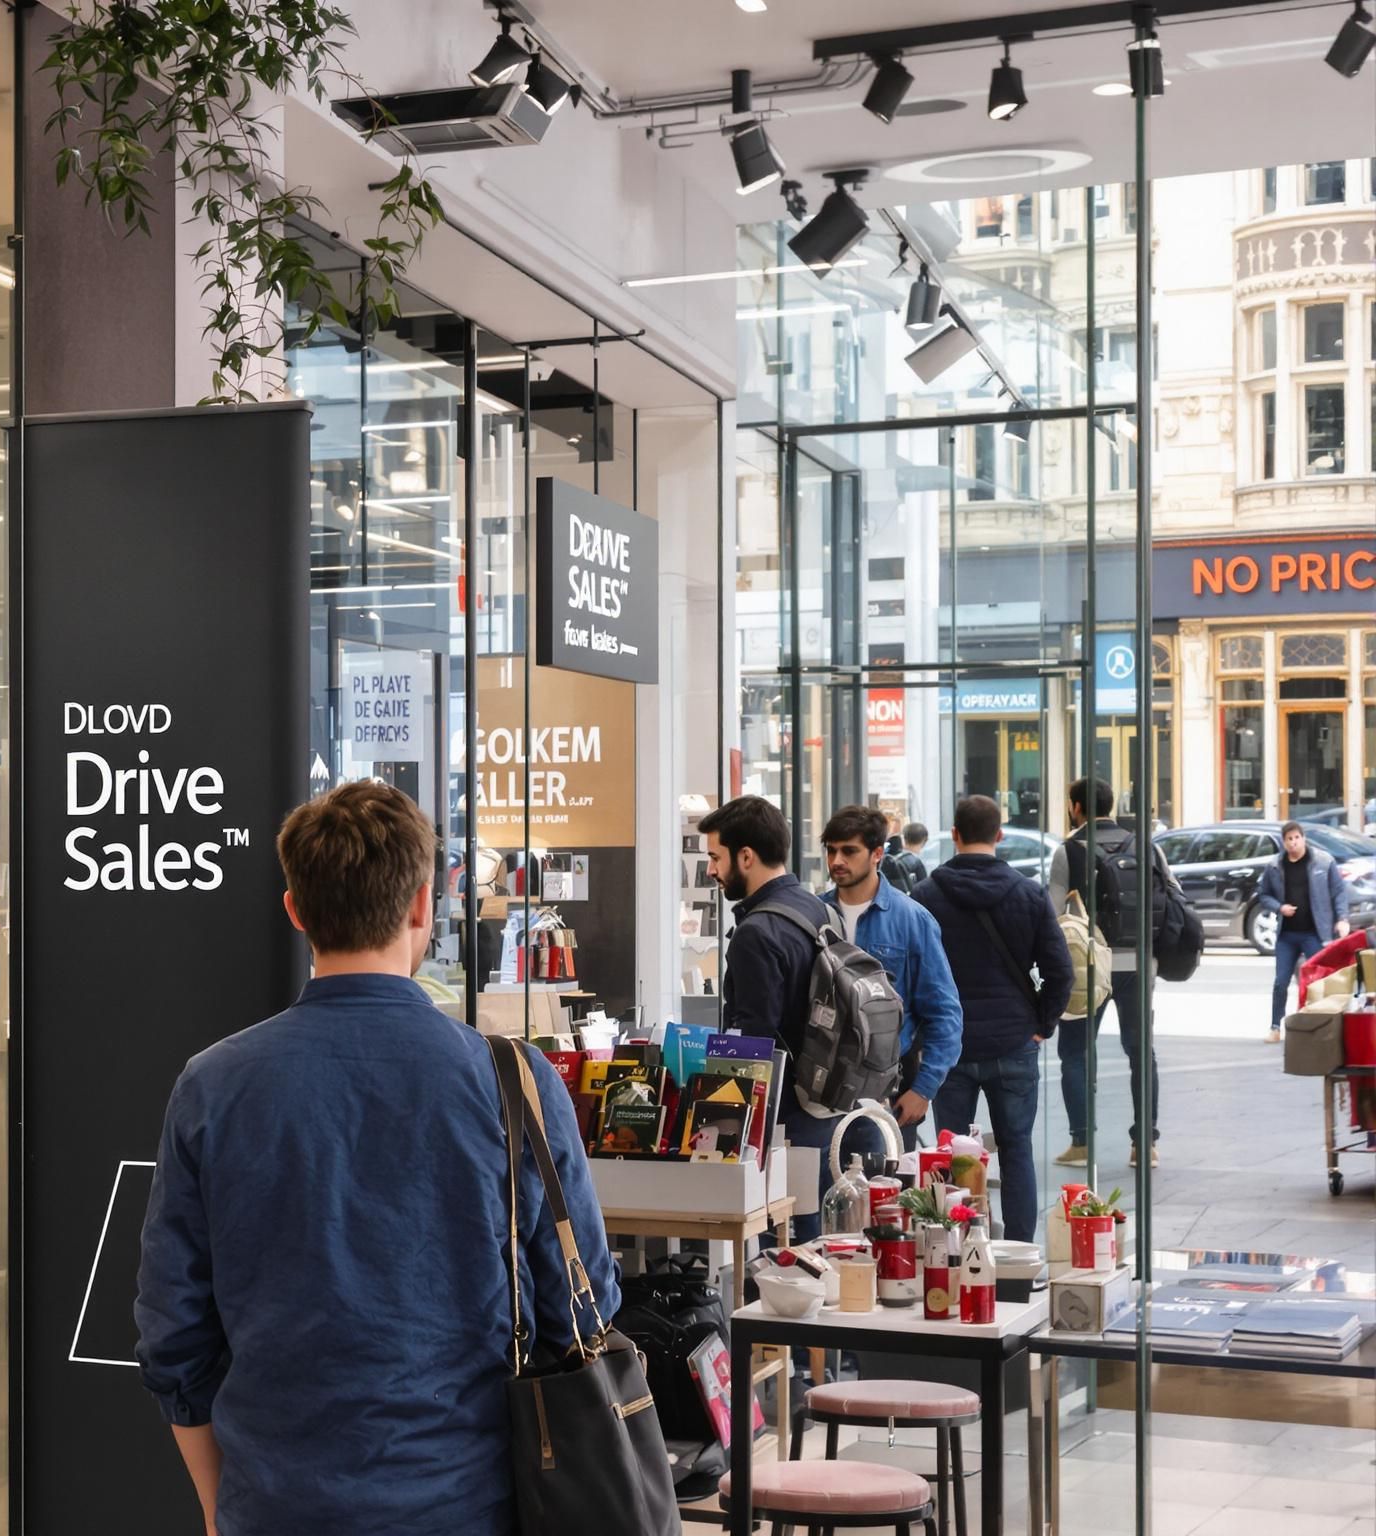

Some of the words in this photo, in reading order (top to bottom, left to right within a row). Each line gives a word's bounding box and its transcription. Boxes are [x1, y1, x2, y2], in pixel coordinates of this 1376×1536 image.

[1192, 555, 1260, 595] NO
[1271, 550, 1376, 593] PRIC
[64, 702, 172, 734] DLOVD
[354, 700, 371, 718] DE
[66, 749, 224, 816] Drive
